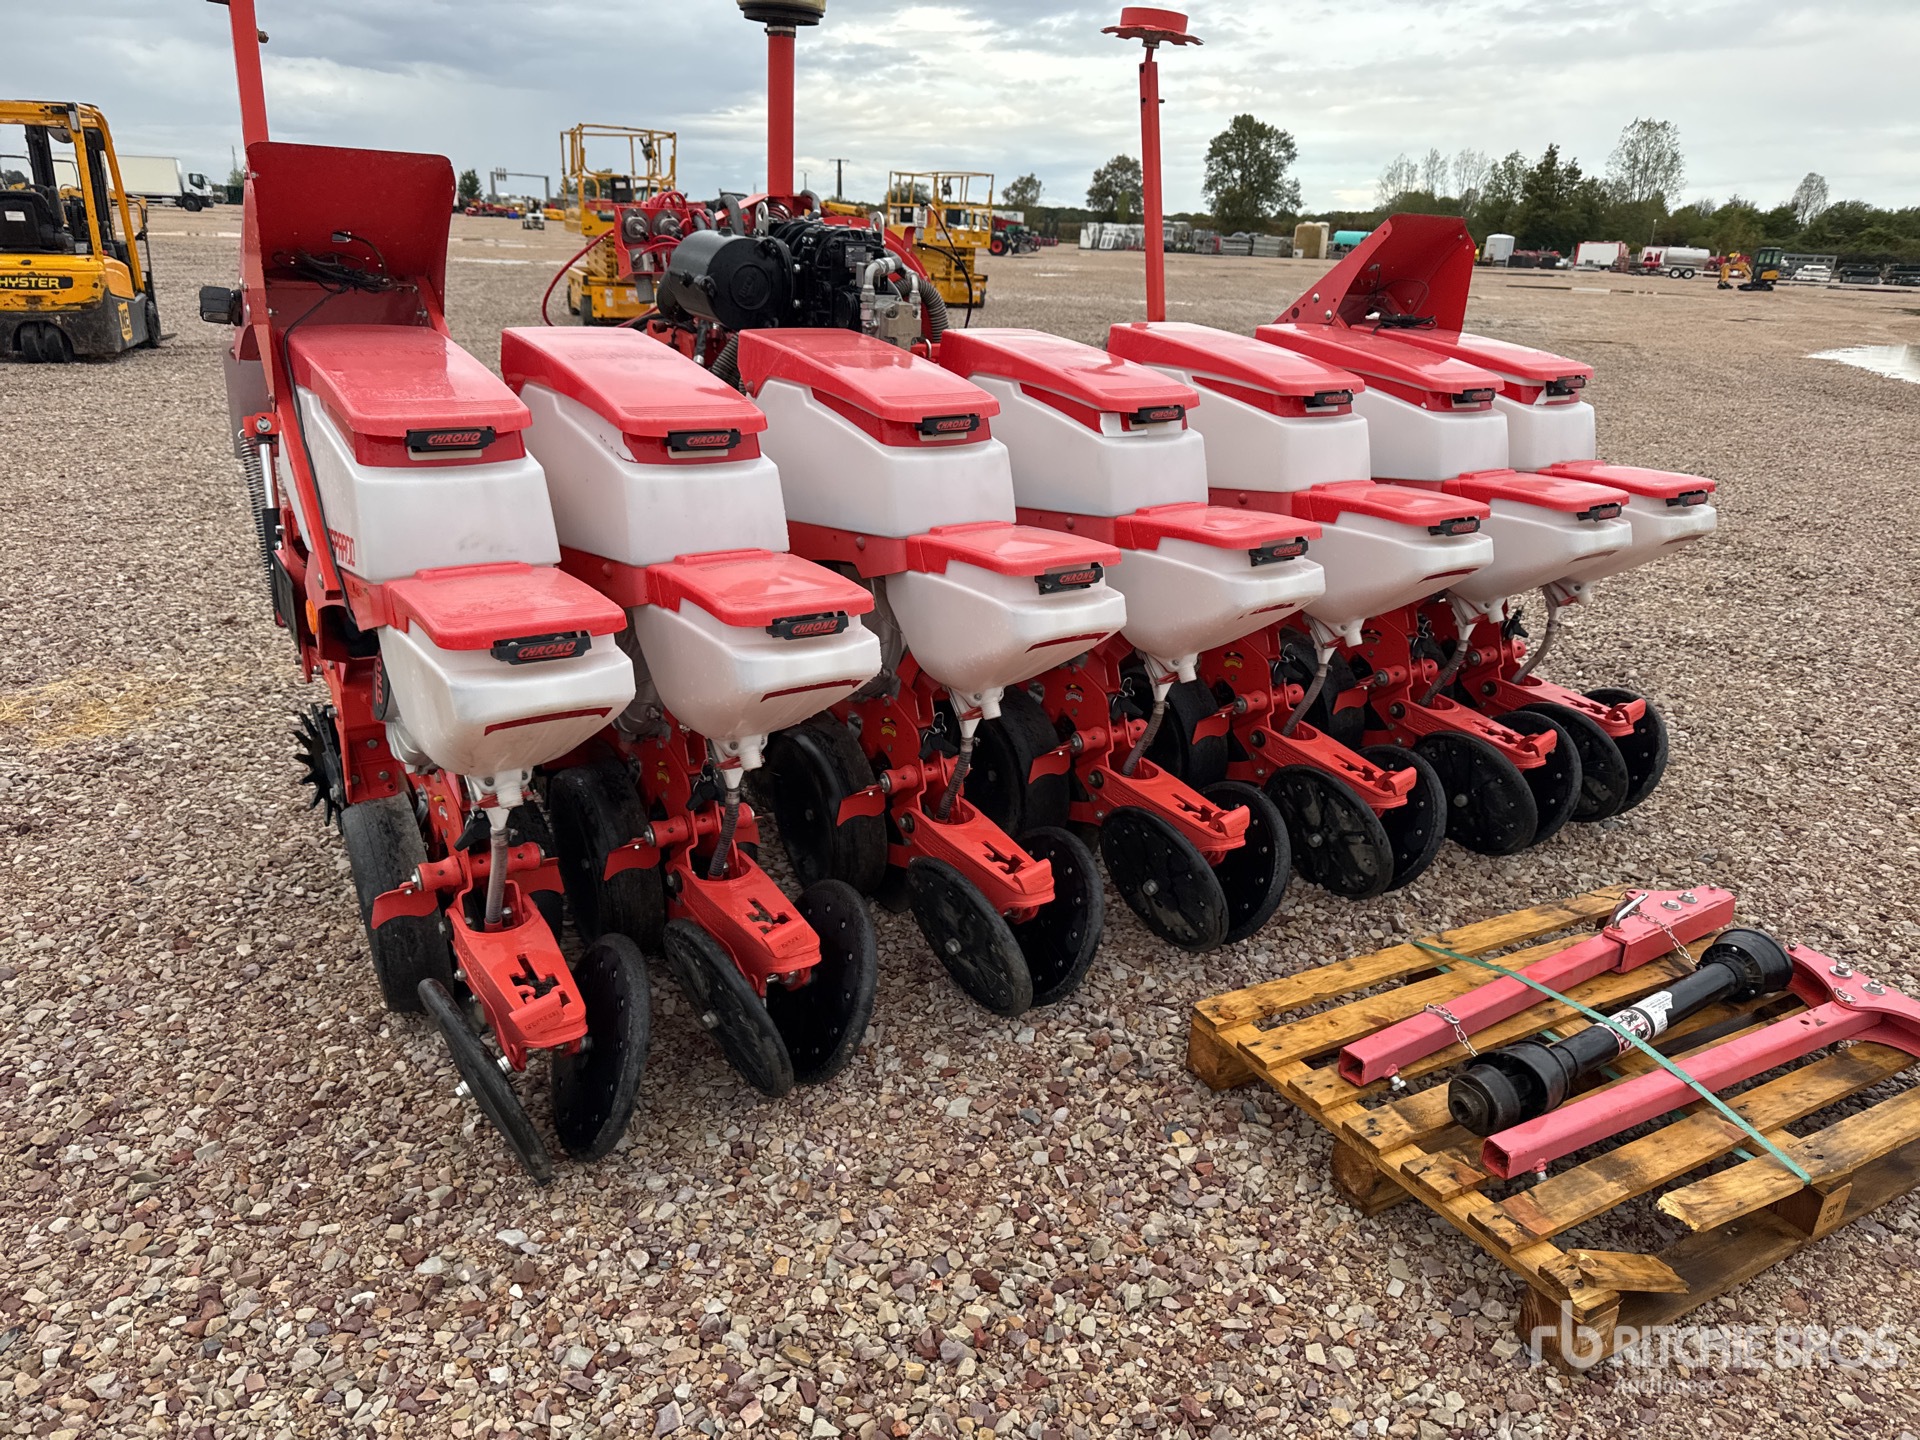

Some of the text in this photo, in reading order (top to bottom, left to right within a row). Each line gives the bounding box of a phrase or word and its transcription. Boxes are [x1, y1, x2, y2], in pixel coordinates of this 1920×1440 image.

[0, 276, 60, 289] HYSTER
[1149, 407, 1181, 419] CHRONO
[935, 417, 972, 431] CHRONO
[426, 432, 481, 446] CHRONO
[685, 433, 731, 447] CHRONO
[1271, 542, 1304, 557] CHRONO
[1058, 568, 1096, 584] CHRONO
[790, 618, 839, 636] CHRONO
[516, 640, 578, 660] CHRONO
